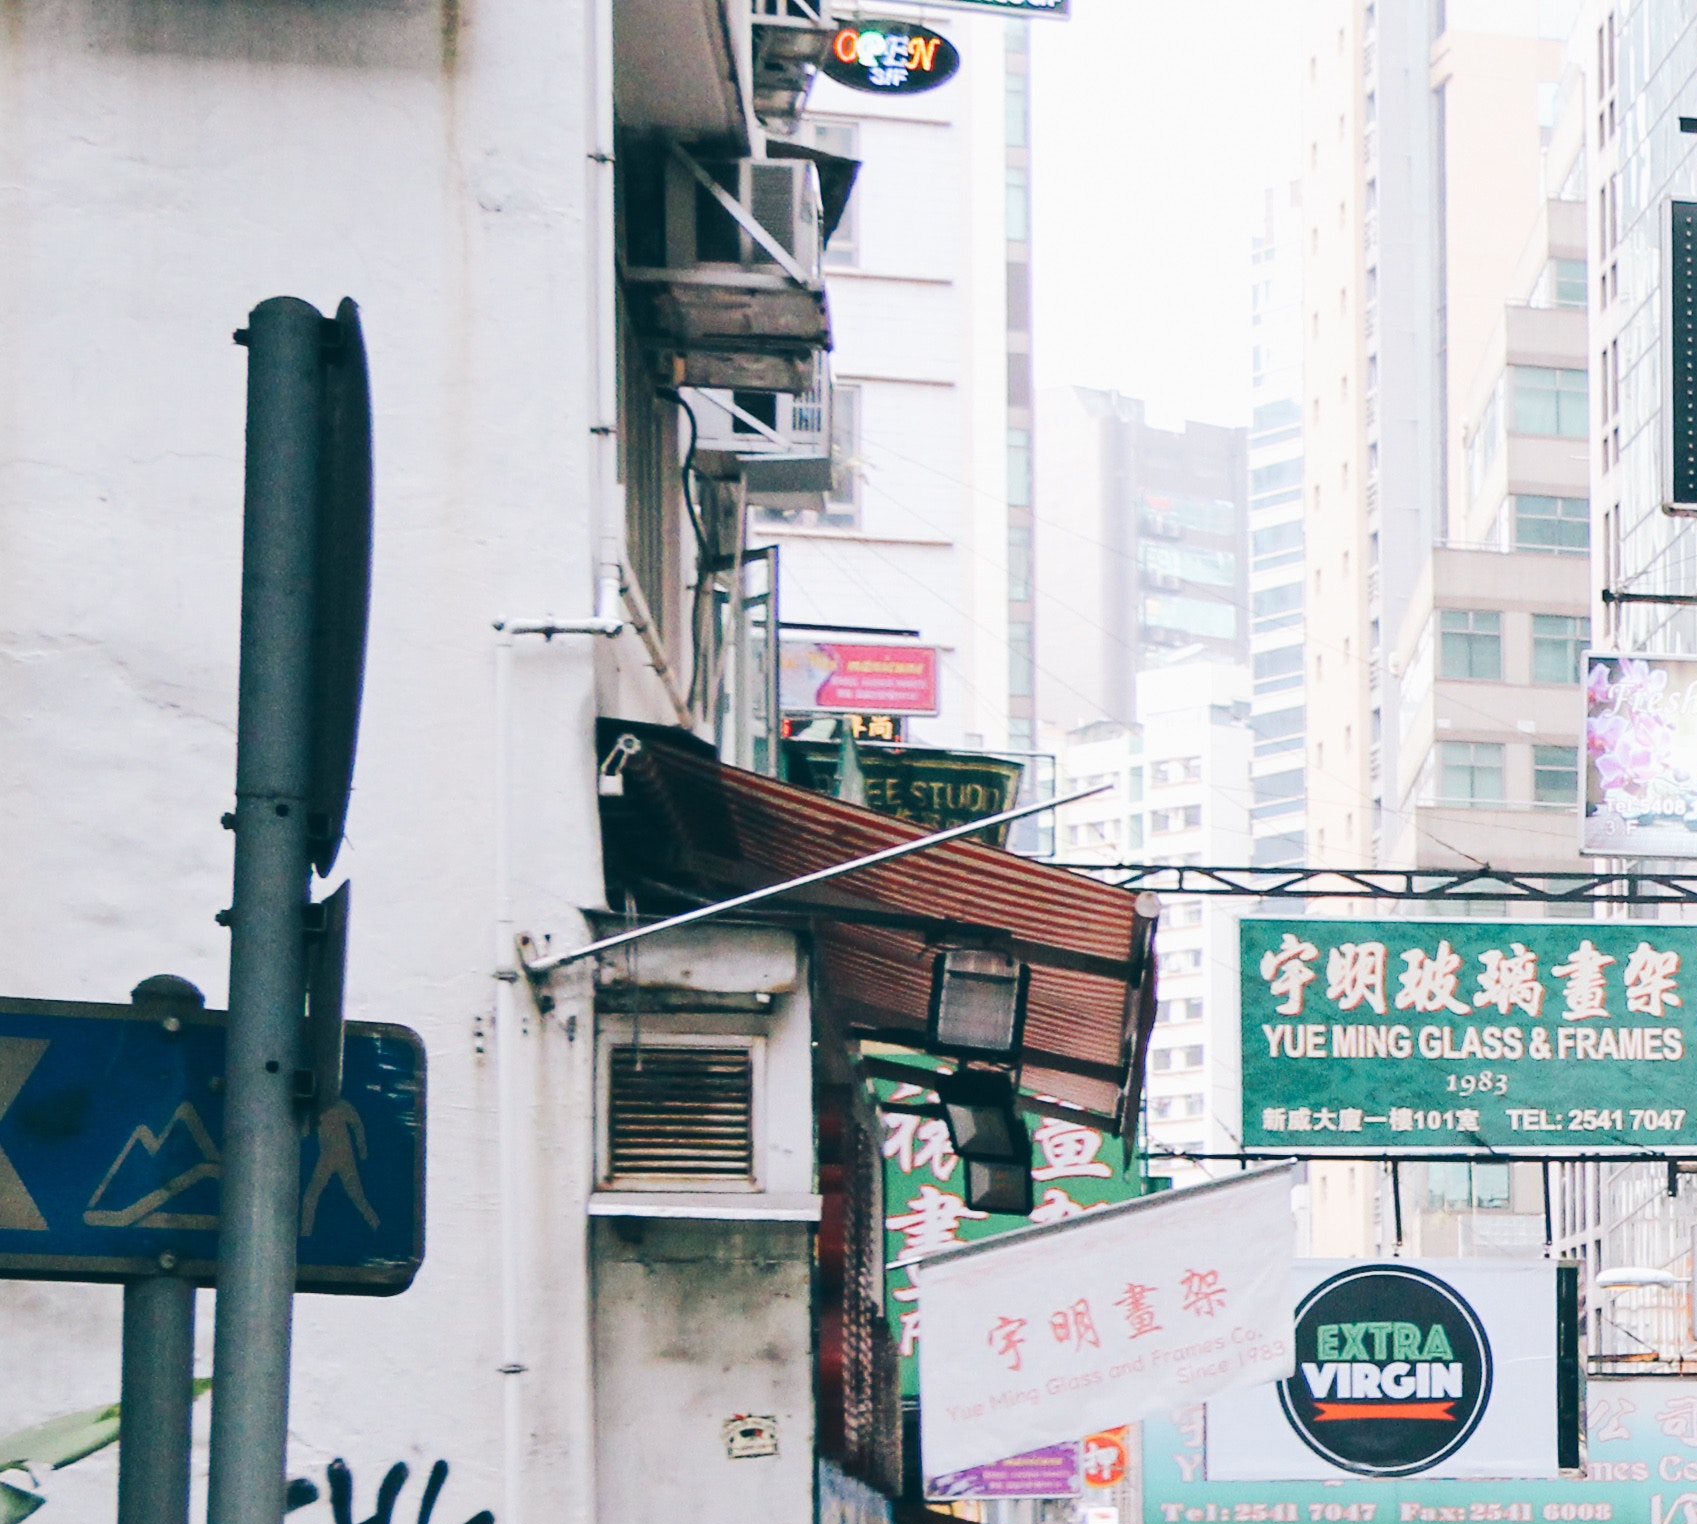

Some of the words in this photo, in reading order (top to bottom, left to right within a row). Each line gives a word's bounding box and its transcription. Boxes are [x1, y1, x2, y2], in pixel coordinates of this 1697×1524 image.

[834, 28, 941, 72] OPEN
[1259, 933, 1684, 1022] 宇明玻璃畫架
[1261, 1023, 1326, 1059] YUE
[1331, 1024, 1413, 1060] MING
[1418, 1025, 1524, 1060] GLASS
[1529, 1028, 1553, 1060] &
[1558, 1026, 1685, 1061] FRAMES
[1446, 1071, 1509, 1098] 1983
[1506, 1108, 1563, 1131] TEL:
[1568, 1108, 1624, 1131] 2541
[1629, 1108, 1685, 1132] 7047
[1315, 1321, 1454, 1363] EXTRA
[1300, 1362, 1464, 1399] VIRGIN
